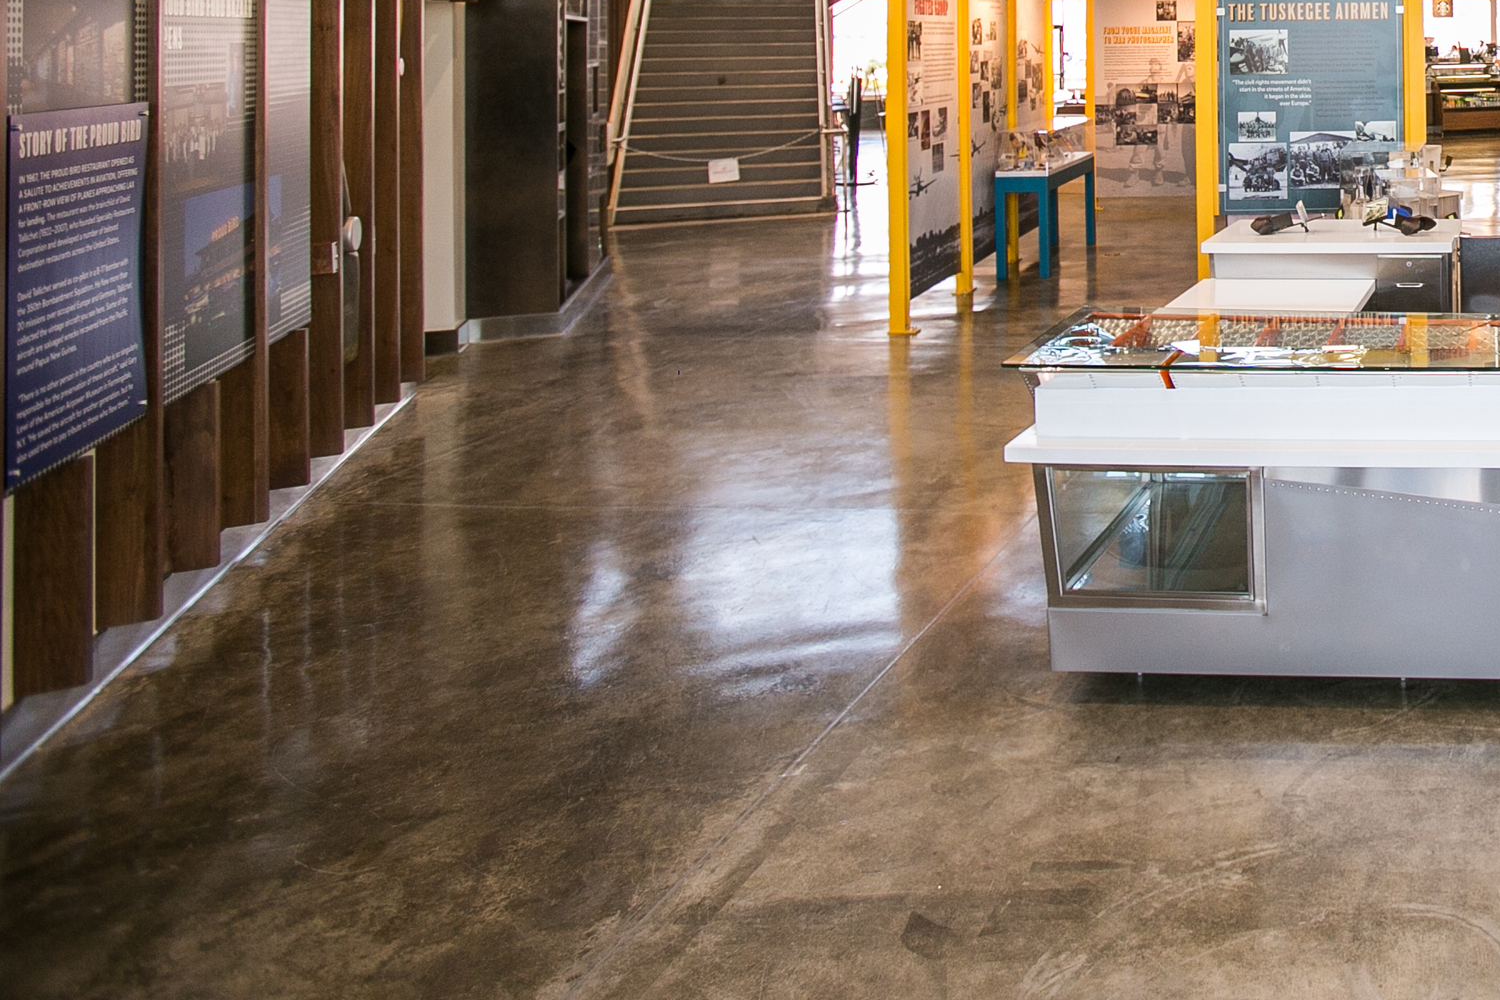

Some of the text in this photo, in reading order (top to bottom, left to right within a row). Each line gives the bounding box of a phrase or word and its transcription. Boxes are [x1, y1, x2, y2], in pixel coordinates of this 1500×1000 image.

[1227, 1, 1389, 22] THE TUSKEGEE AIRMEN
[1103, 26, 1172, 34] FROM VOGUE MAGAZINE
[1104, 36, 1174, 44] TO WAR PHOTOGRAPHER
[19, 119, 141, 159] STORY OF THE PROUD BIRD
[40, 171, 51, 180] THE
[51, 167, 69, 179] PROUD
[69, 165, 80, 175] BIRD
[81, 160, 111, 174] RESTAURANT
[23, 186, 44, 199] SALUTE
[45, 184, 52, 194] TO
[52, 178, 90, 193] ACHIEVEMENTS
[77, 190, 96, 201] PLANES
